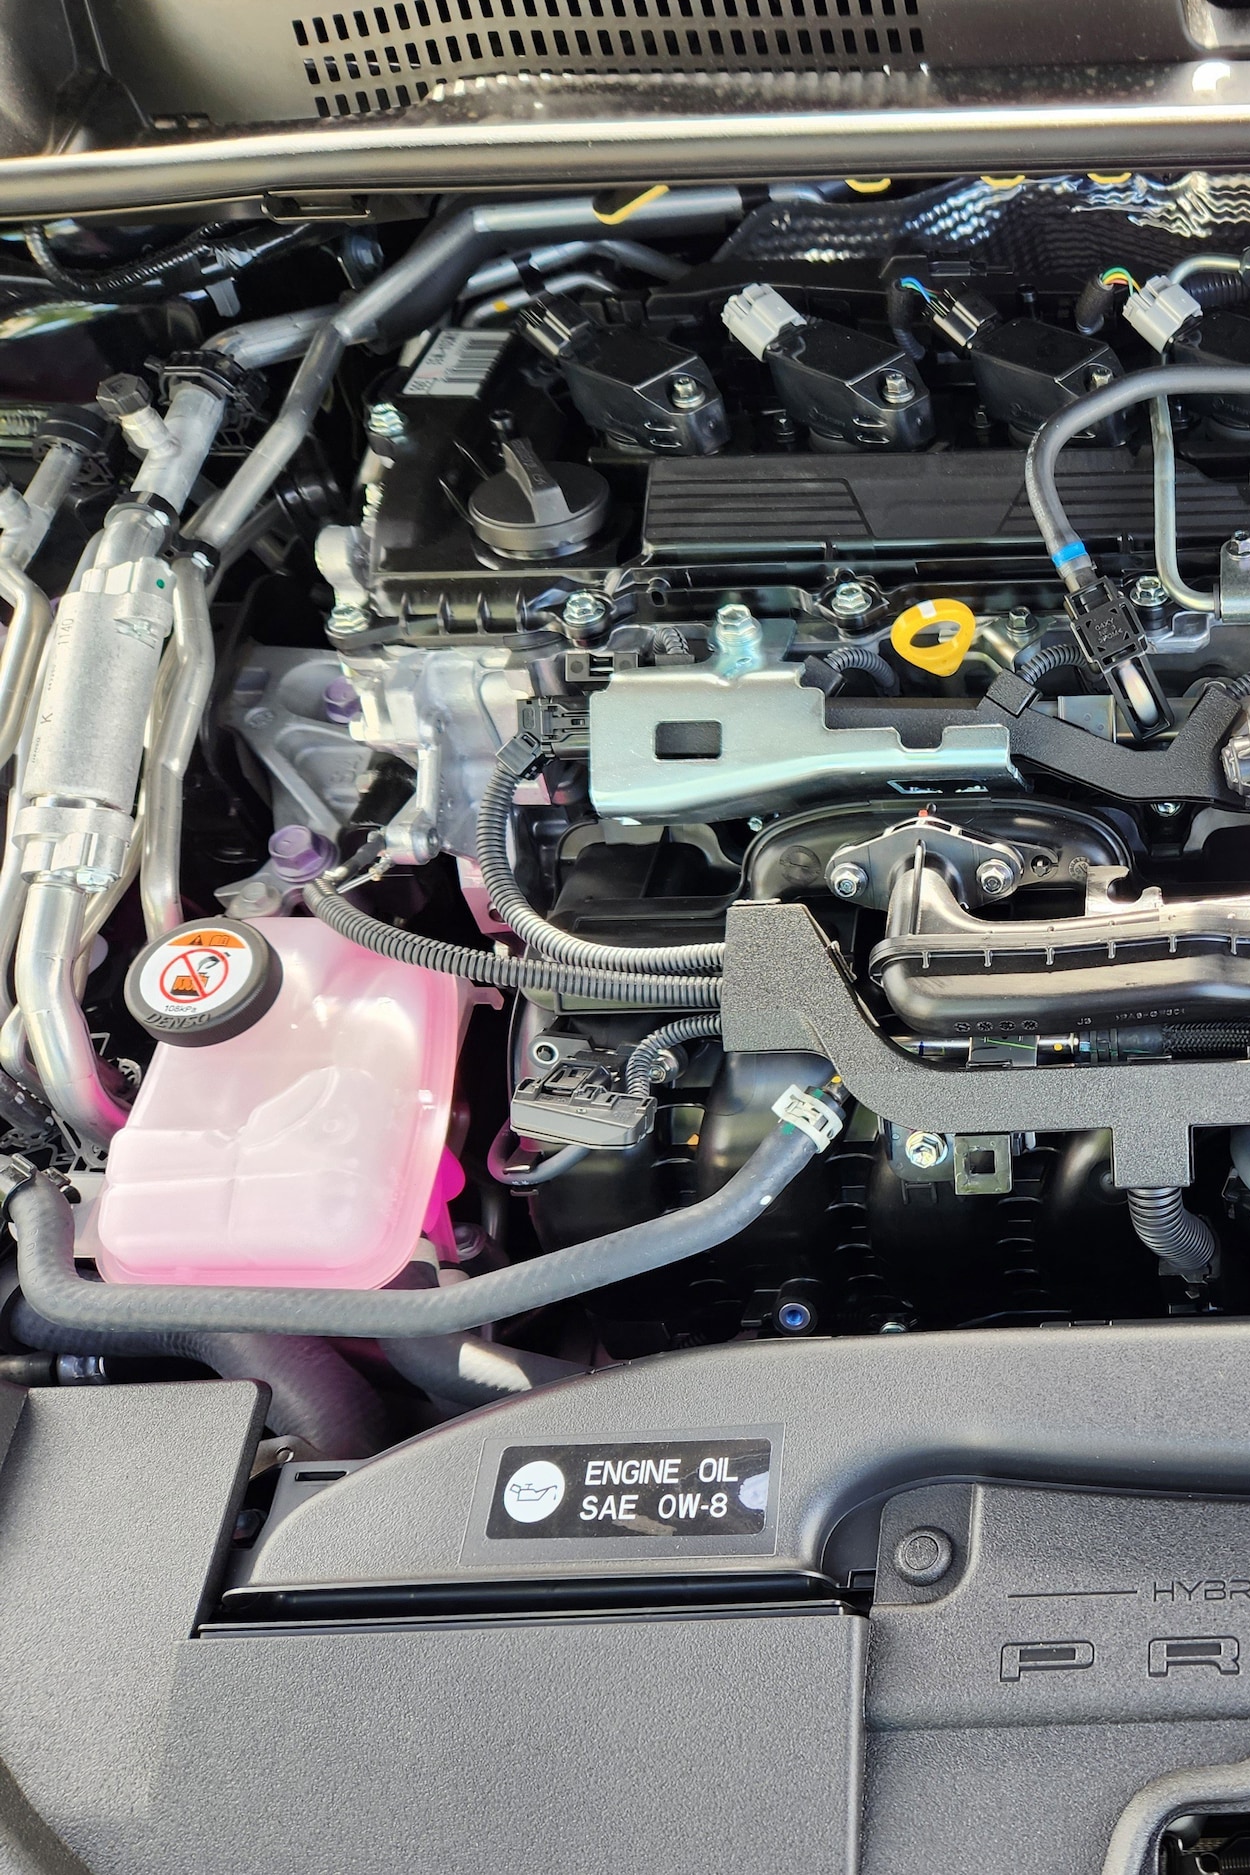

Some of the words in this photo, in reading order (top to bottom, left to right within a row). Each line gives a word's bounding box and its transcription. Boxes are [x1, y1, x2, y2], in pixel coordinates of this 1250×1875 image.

[143, 1013, 212, 1030] DENSO
[584, 1459, 681, 1486] ENGINE
[699, 1457, 739, 1483] OIL
[579, 1494, 639, 1521] SAE
[657, 1492, 728, 1520] 0W-8
